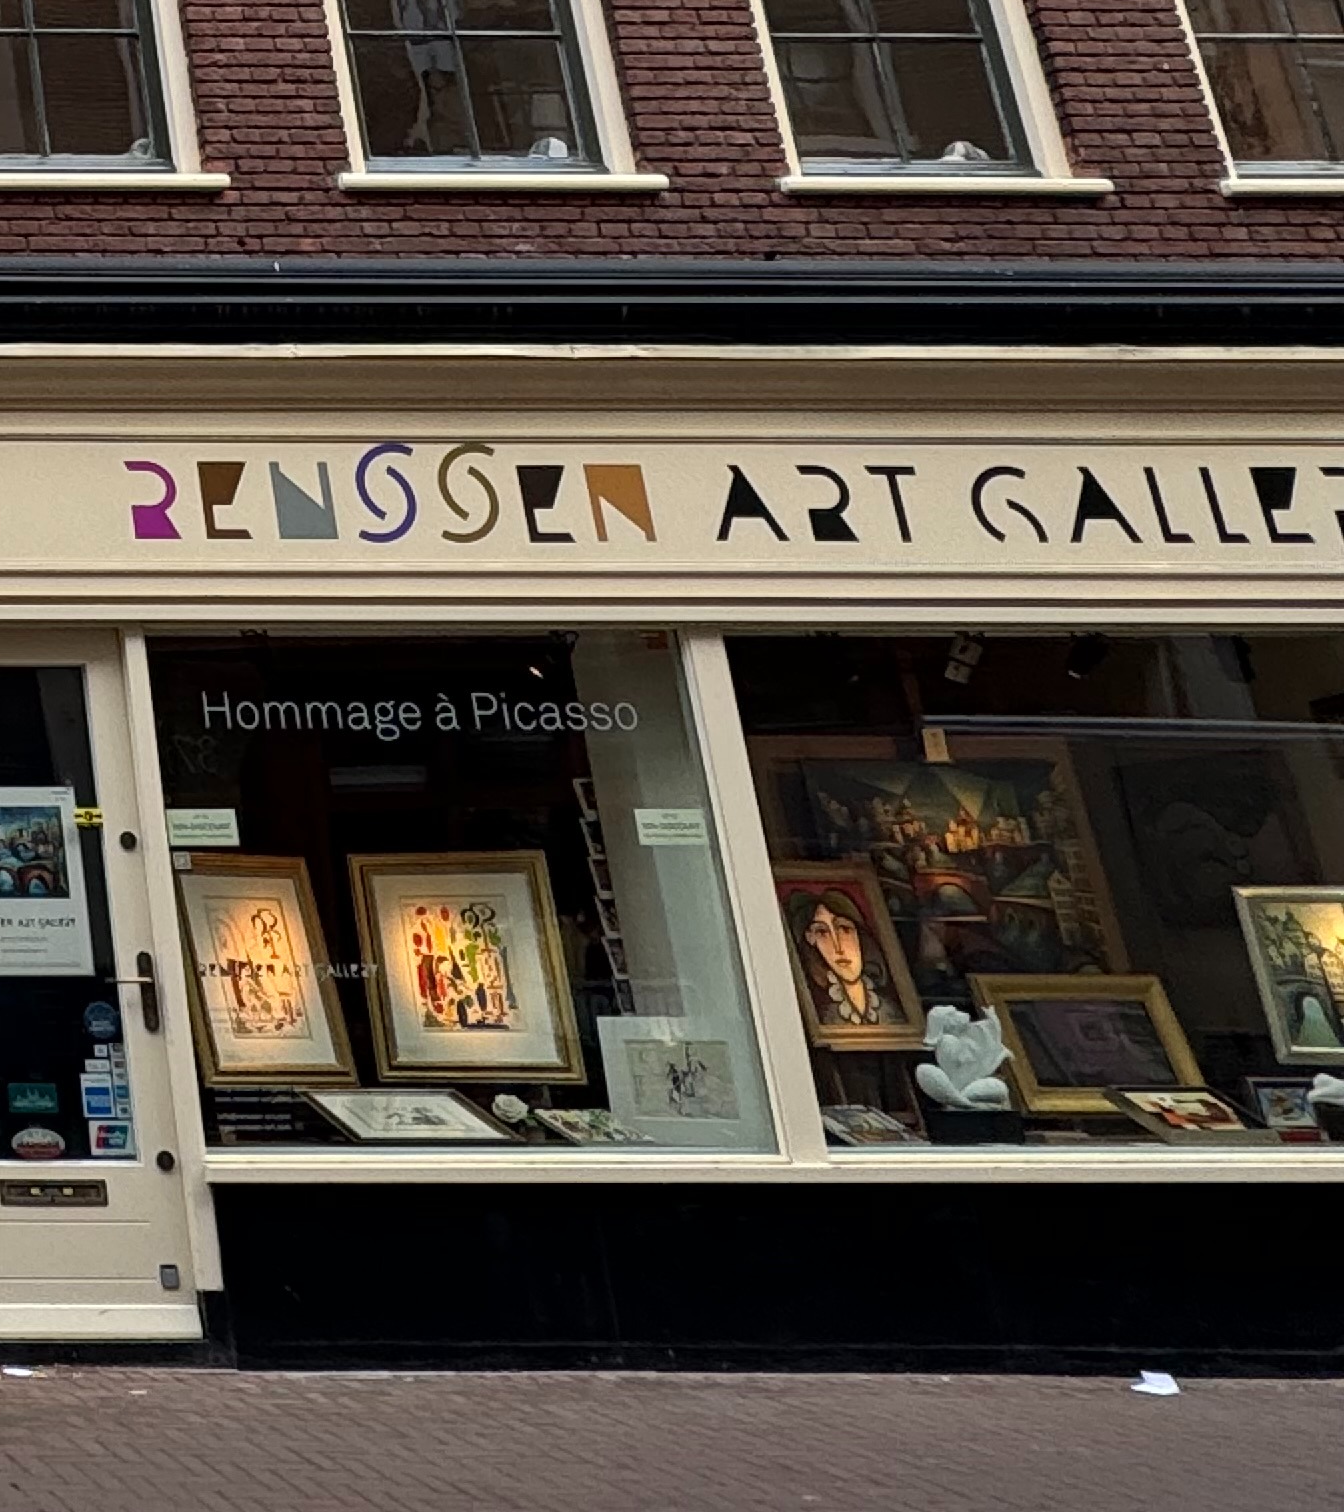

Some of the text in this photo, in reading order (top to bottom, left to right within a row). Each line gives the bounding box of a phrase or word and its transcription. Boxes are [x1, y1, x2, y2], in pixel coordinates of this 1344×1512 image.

[123, 442, 657, 544] RENSSEN
[715, 464, 916, 543] ART
[201, 690, 639, 741] Hommage à Picasso
